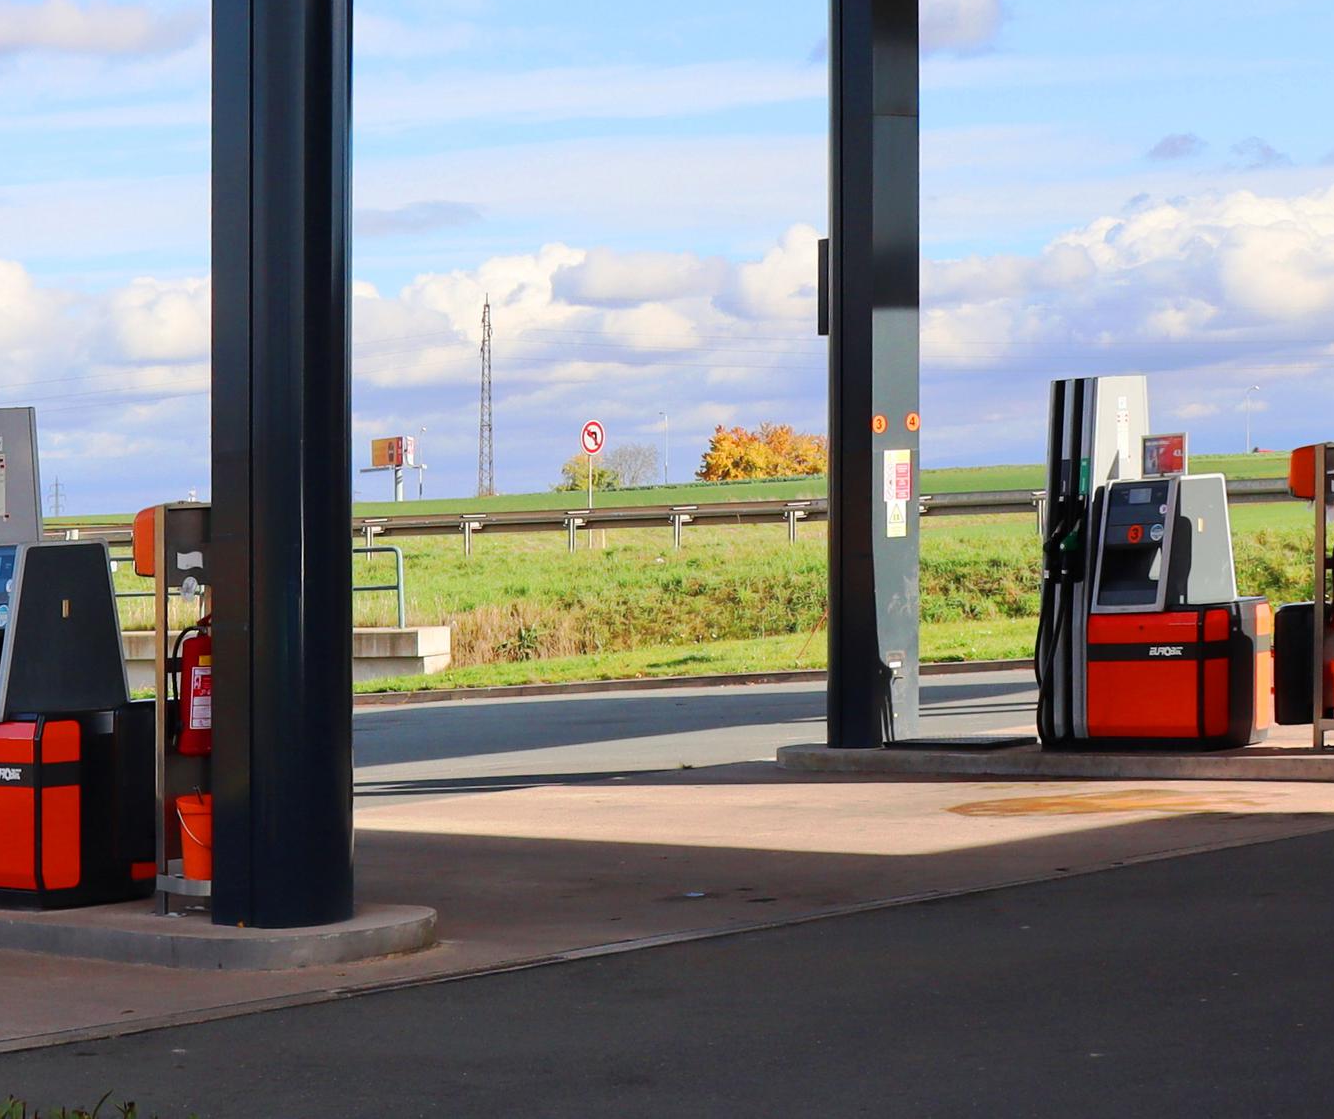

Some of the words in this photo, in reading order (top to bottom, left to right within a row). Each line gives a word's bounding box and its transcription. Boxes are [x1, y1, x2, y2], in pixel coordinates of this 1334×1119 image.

[876, 418, 883, 430] 3
[909, 416, 916, 427] 4
[1130, 528, 1139, 540] 3
